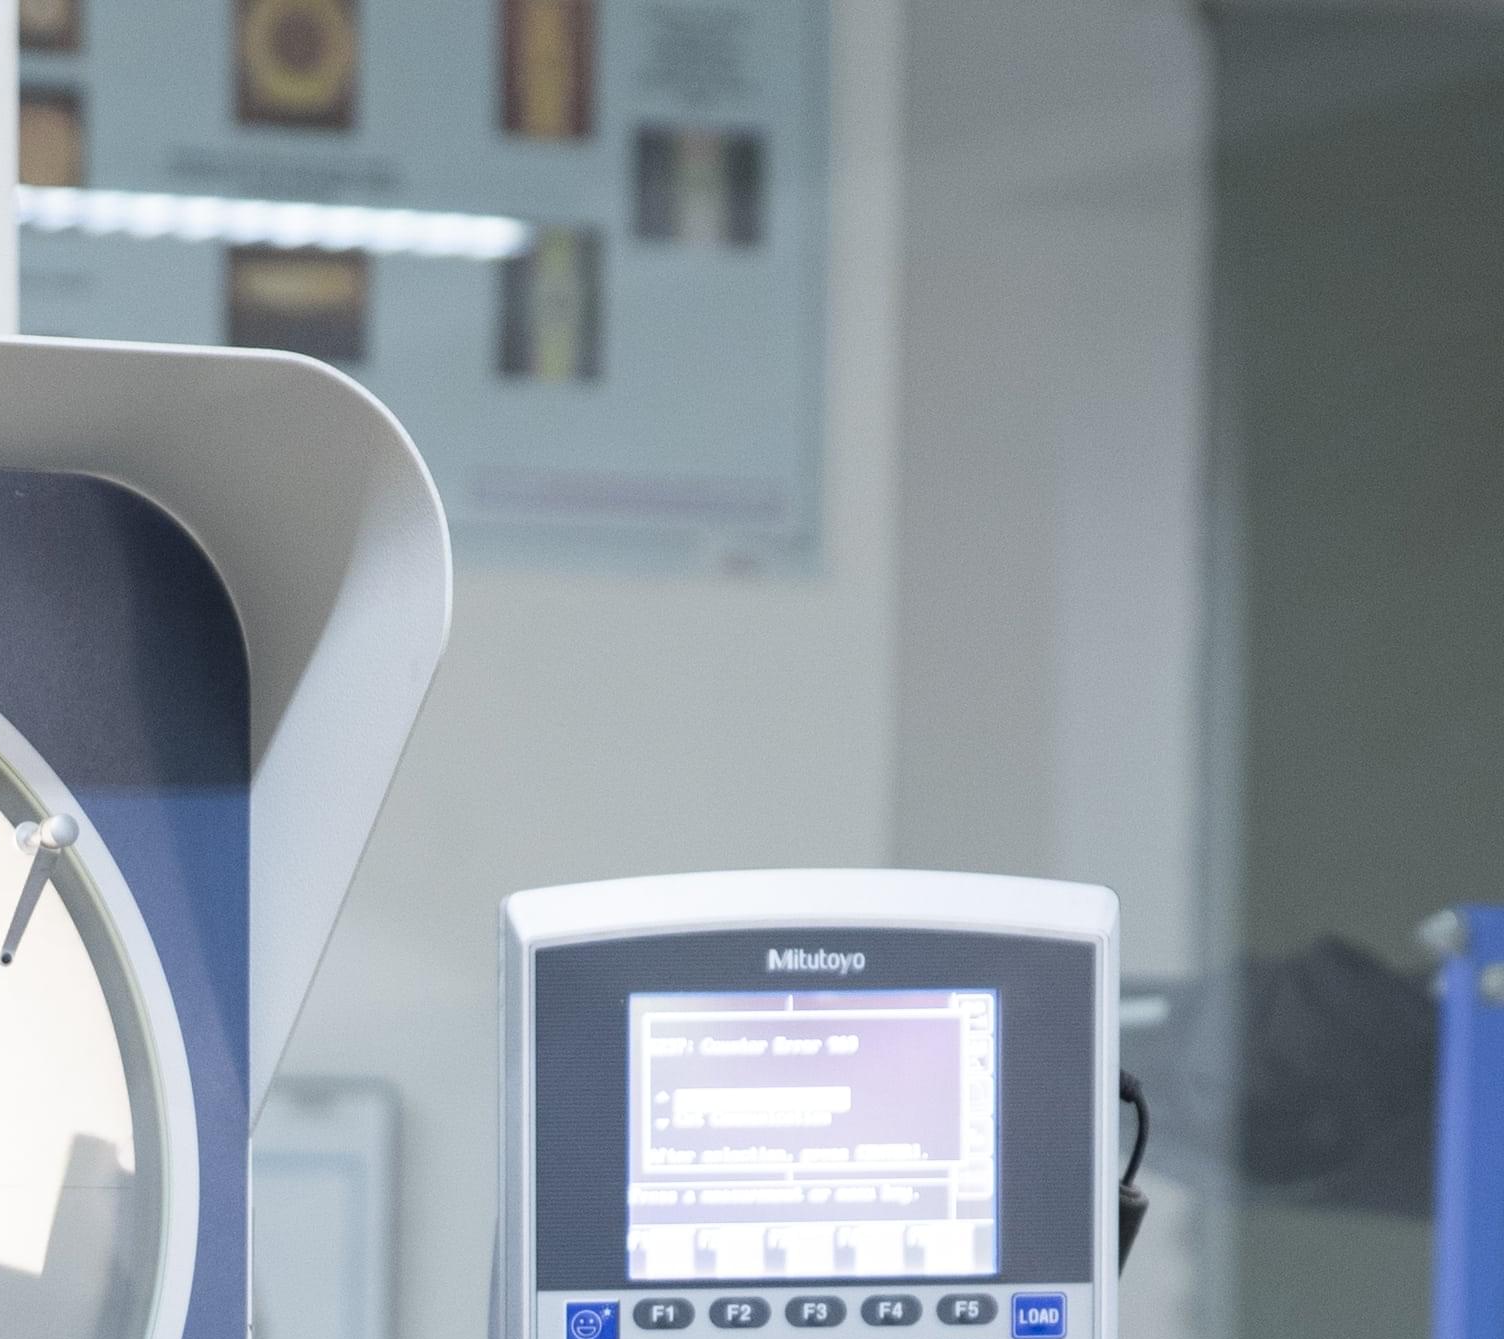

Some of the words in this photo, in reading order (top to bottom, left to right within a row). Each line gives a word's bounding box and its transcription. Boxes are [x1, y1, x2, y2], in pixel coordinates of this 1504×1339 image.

[768, 947, 866, 975] Mitutoyo
[651, 1305, 675, 1322] F1
[726, 1304, 752, 1321] F2
[802, 1303, 828, 1320] F3
[879, 1301, 904, 1319] F4
[954, 1300, 980, 1318] F5
[1019, 1307, 1060, 1325] LOAD
